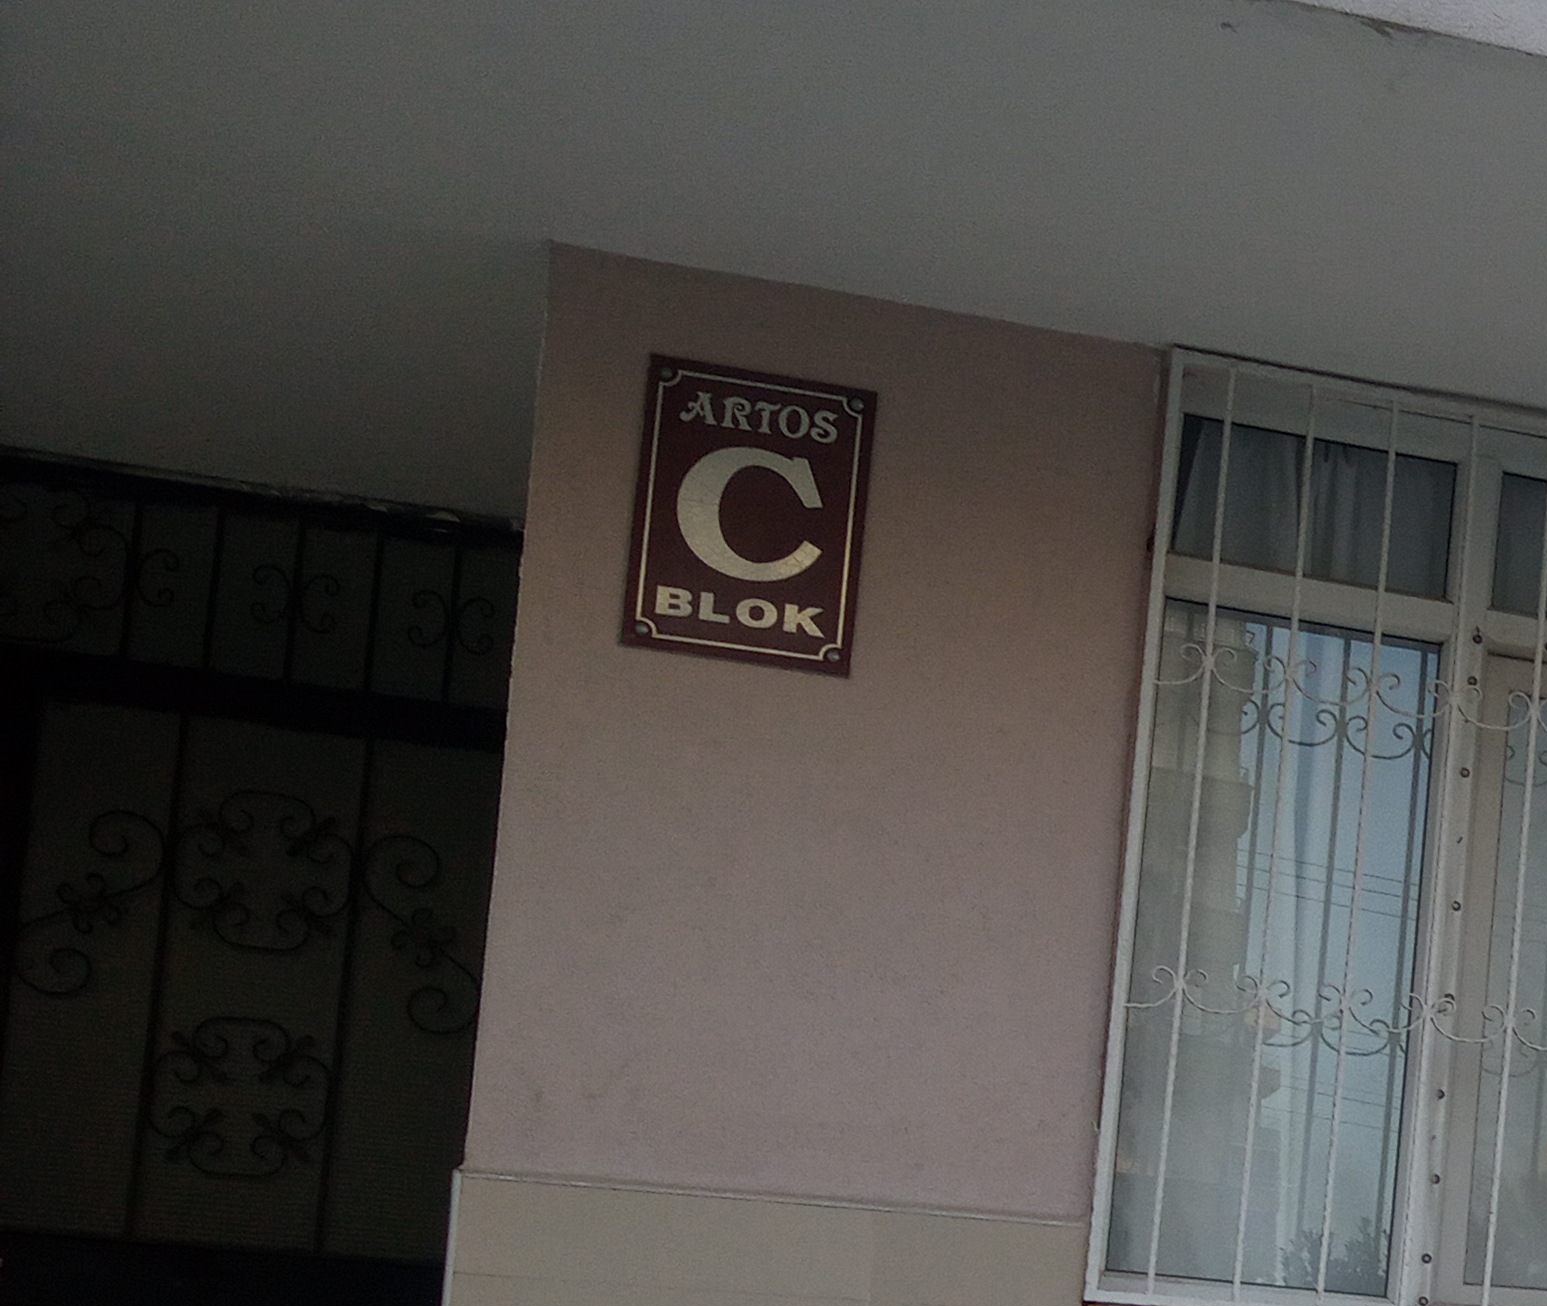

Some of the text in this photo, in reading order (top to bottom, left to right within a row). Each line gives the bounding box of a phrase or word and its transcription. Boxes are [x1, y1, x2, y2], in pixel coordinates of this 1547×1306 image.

[679, 391, 839, 443] ARTOS
[676, 446, 823, 582] C
[654, 585, 825, 639] BLOK
